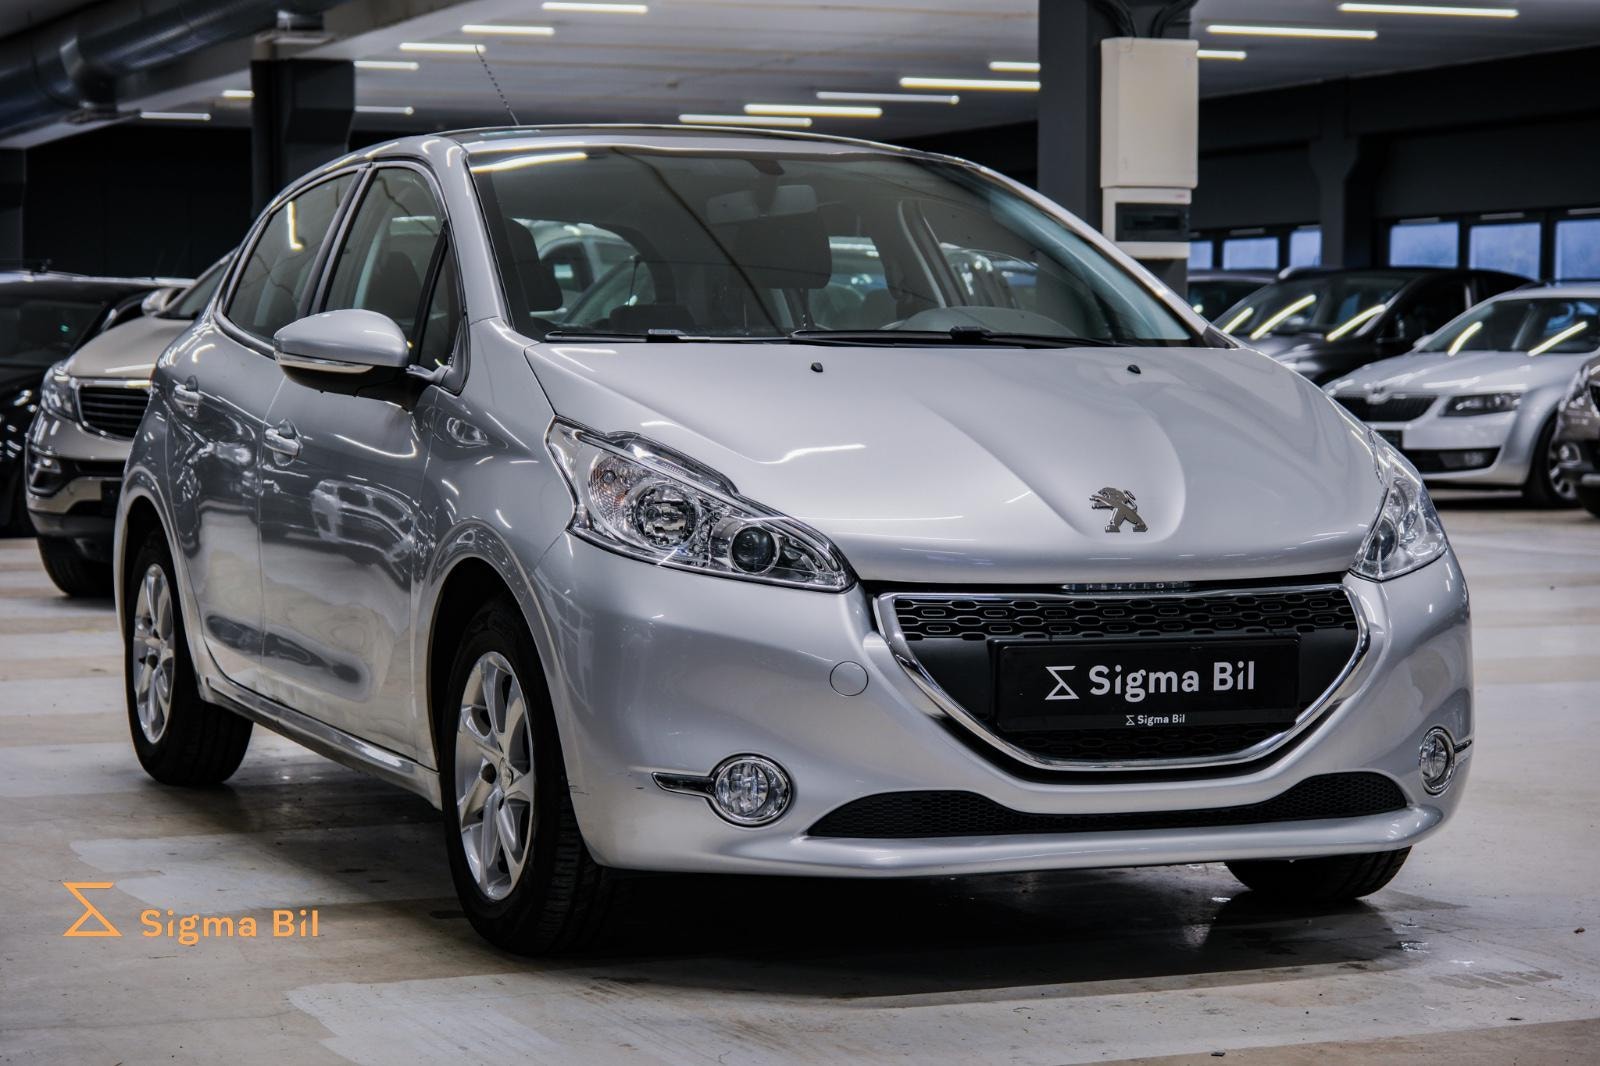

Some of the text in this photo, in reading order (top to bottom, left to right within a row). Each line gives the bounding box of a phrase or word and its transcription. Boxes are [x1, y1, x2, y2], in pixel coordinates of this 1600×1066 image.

[1089, 661, 1255, 703] Sigma Bil
[1137, 713, 1187, 727] Sigma Bil
